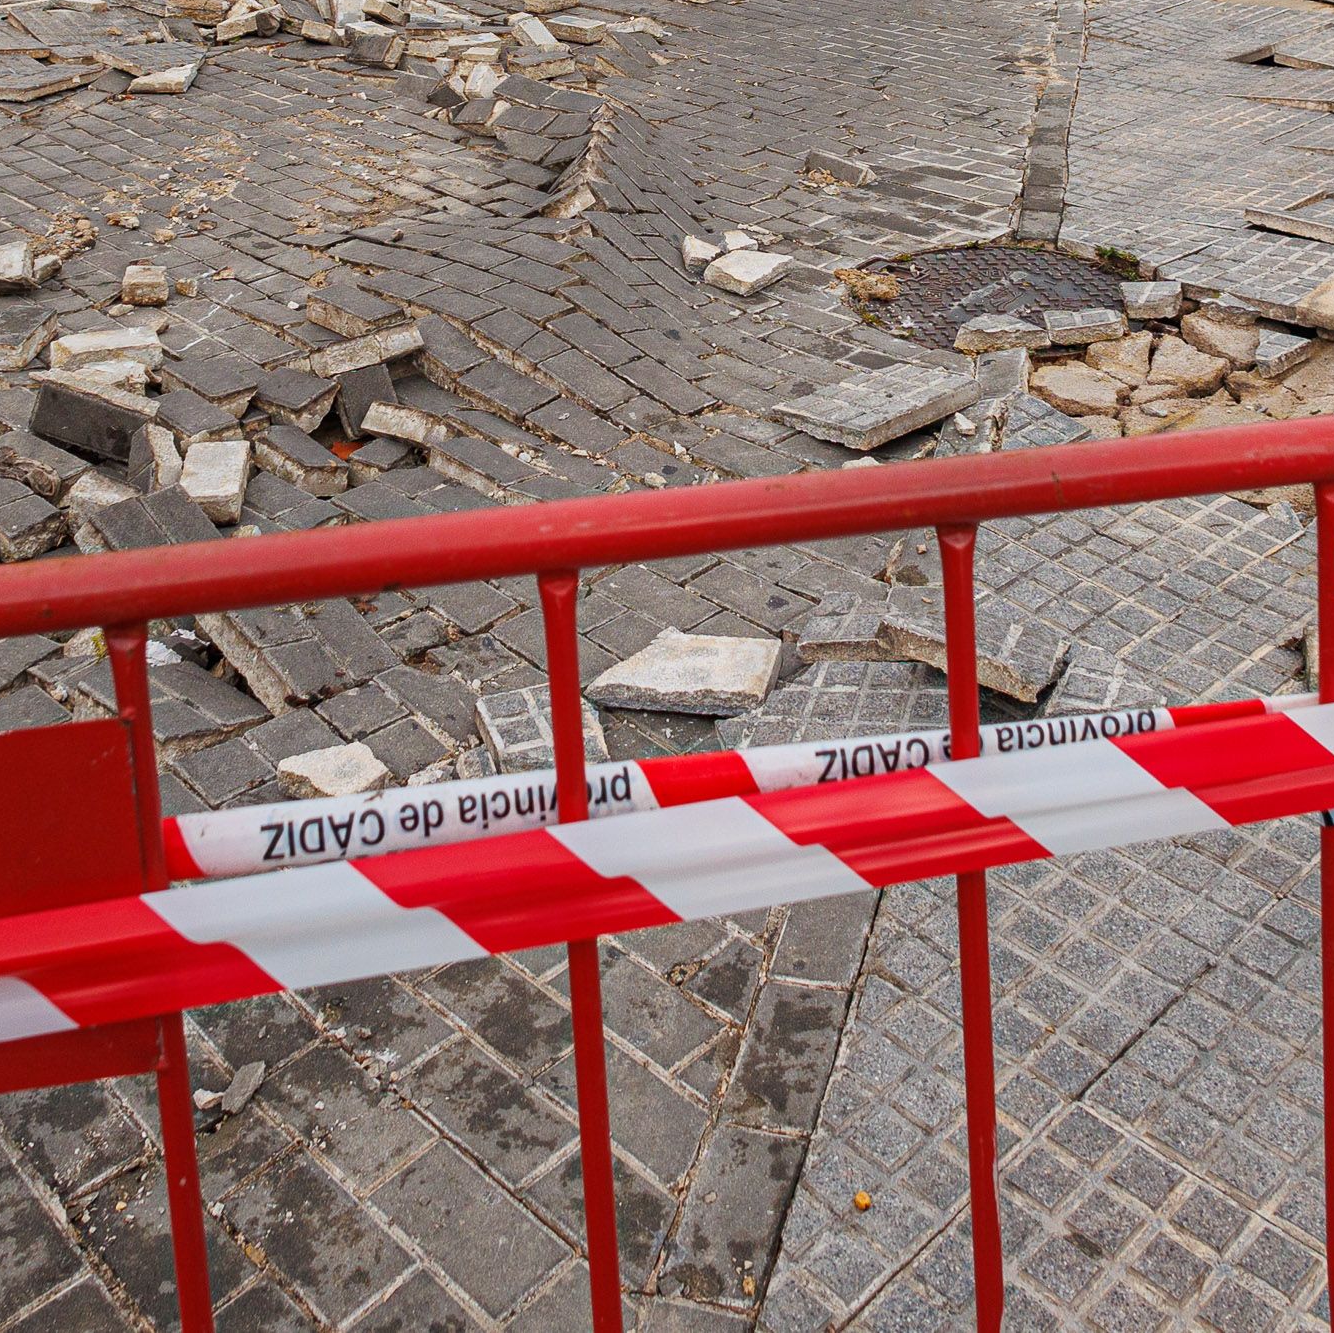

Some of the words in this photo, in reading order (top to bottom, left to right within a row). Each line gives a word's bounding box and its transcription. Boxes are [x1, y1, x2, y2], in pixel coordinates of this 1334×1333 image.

[400, 800, 444, 837] de
[458, 767, 632, 830] princia
[260, 809, 385, 860] CÁDIZ
